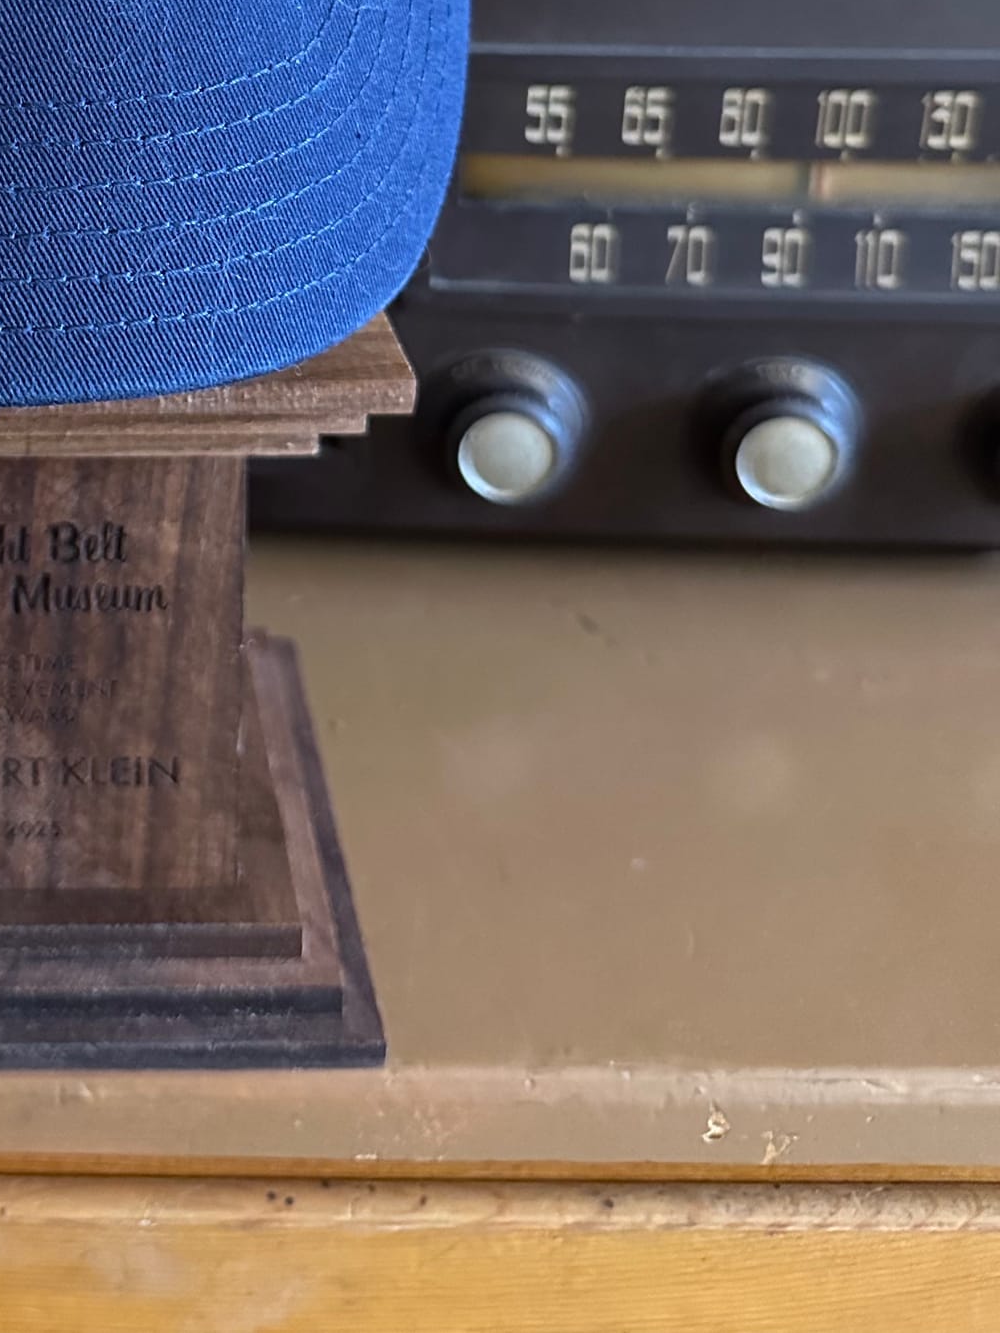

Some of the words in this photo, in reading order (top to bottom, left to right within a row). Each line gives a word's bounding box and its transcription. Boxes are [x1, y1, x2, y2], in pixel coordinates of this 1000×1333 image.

[524, 84, 574, 144] 55
[622, 86, 673, 147] 65
[816, 89, 873, 149] 100
[920, 90, 977, 151] 130
[569, 222, 617, 285] 60
[665, 224, 714, 286] 70
[761, 226, 811, 288] 90
[854, 228, 903, 290] 110
[951, 229, 1000, 291] 150
[47, 521, 128, 564] Belt
[11, 572, 169, 615] Museum
[60, 754, 181, 786] KLEIN
